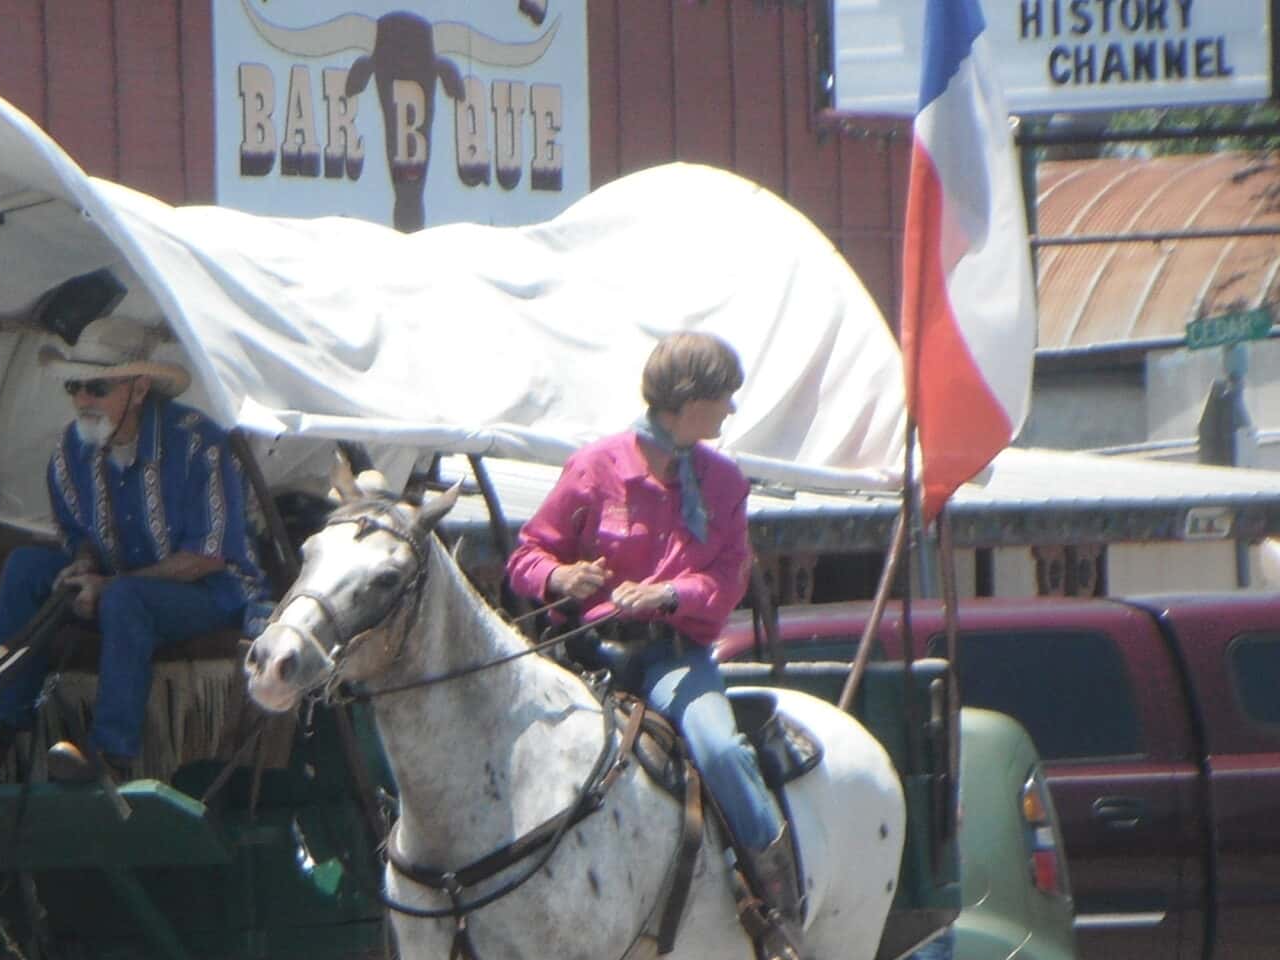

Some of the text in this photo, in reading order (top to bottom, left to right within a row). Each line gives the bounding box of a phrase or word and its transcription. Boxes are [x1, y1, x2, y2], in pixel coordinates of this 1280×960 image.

[1020, 0, 1193, 37] HISTORY
[1048, 36, 1234, 85] CHANNEL
[238, 62, 563, 191] BAR B QUE
